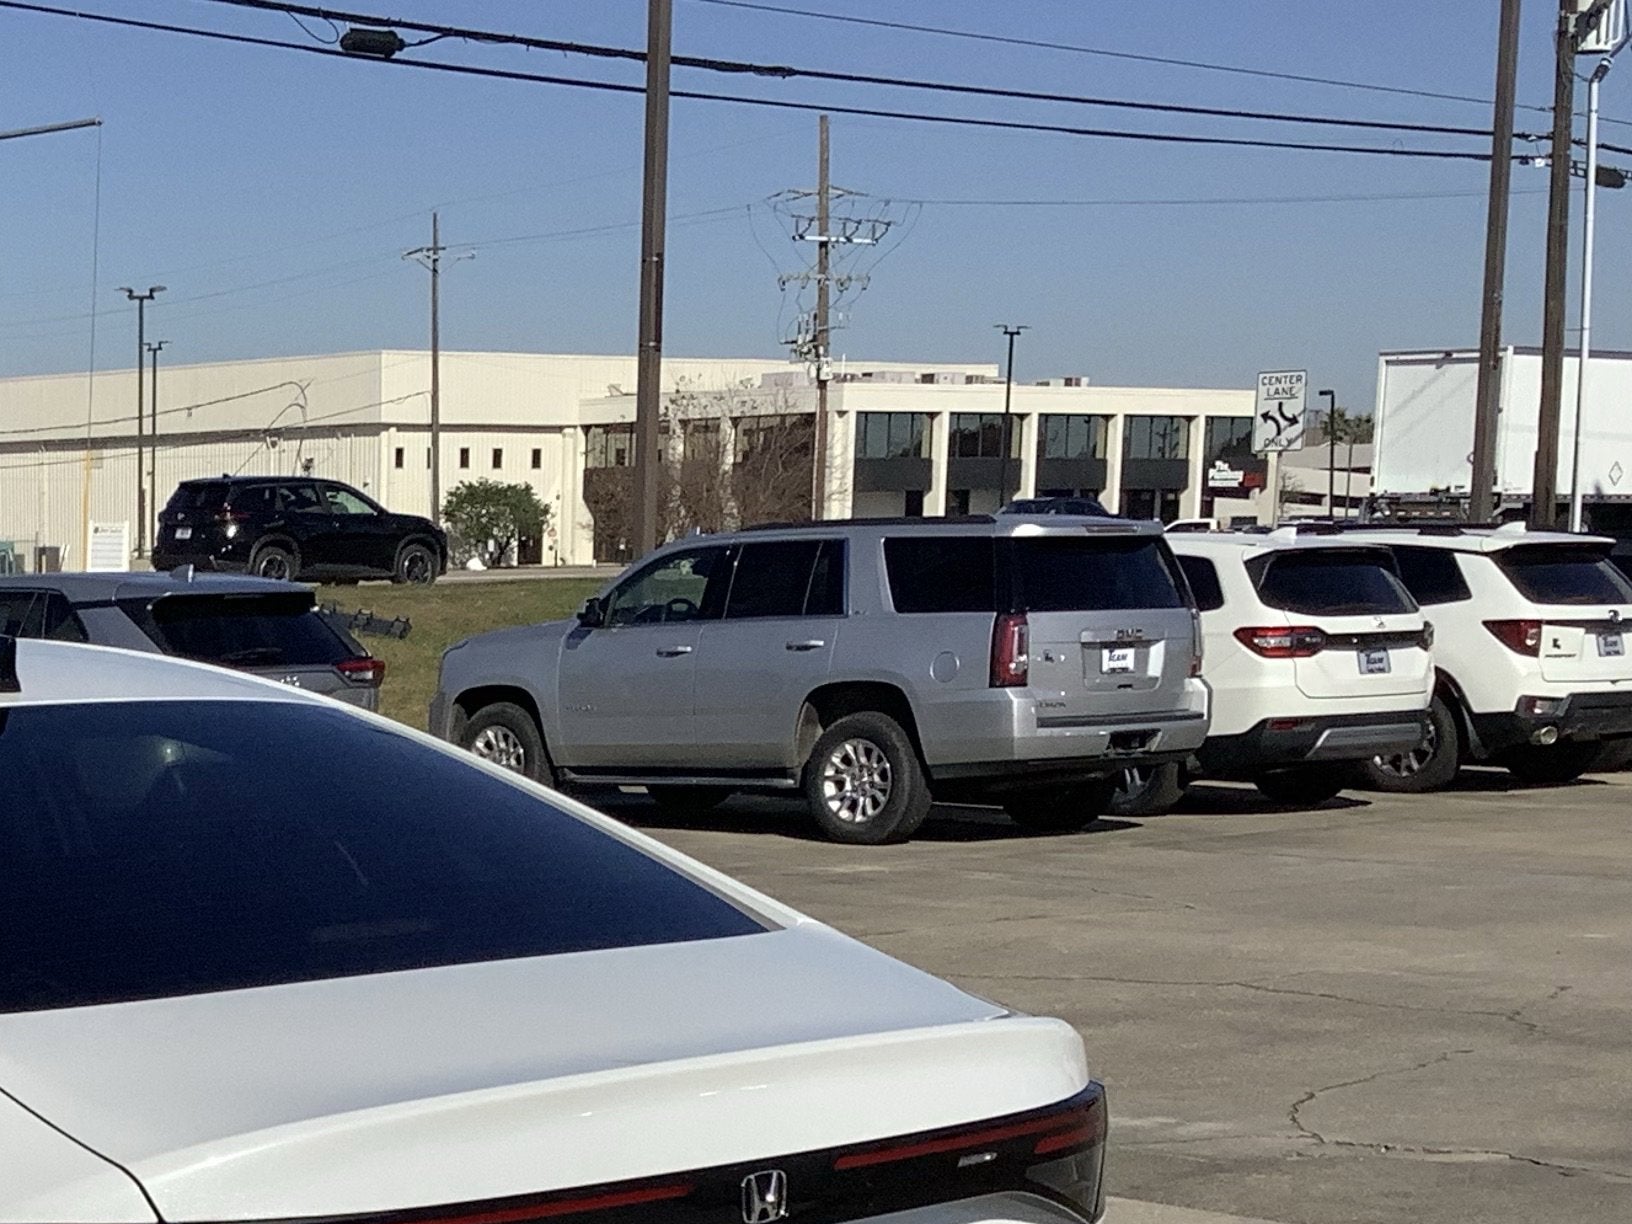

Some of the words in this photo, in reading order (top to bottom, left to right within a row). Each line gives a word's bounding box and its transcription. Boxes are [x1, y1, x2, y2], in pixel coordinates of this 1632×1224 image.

[1261, 374, 1303, 386] CENTER
[1267, 386, 1296, 397] LANE
[1263, 437, 1294, 449] ONLY
